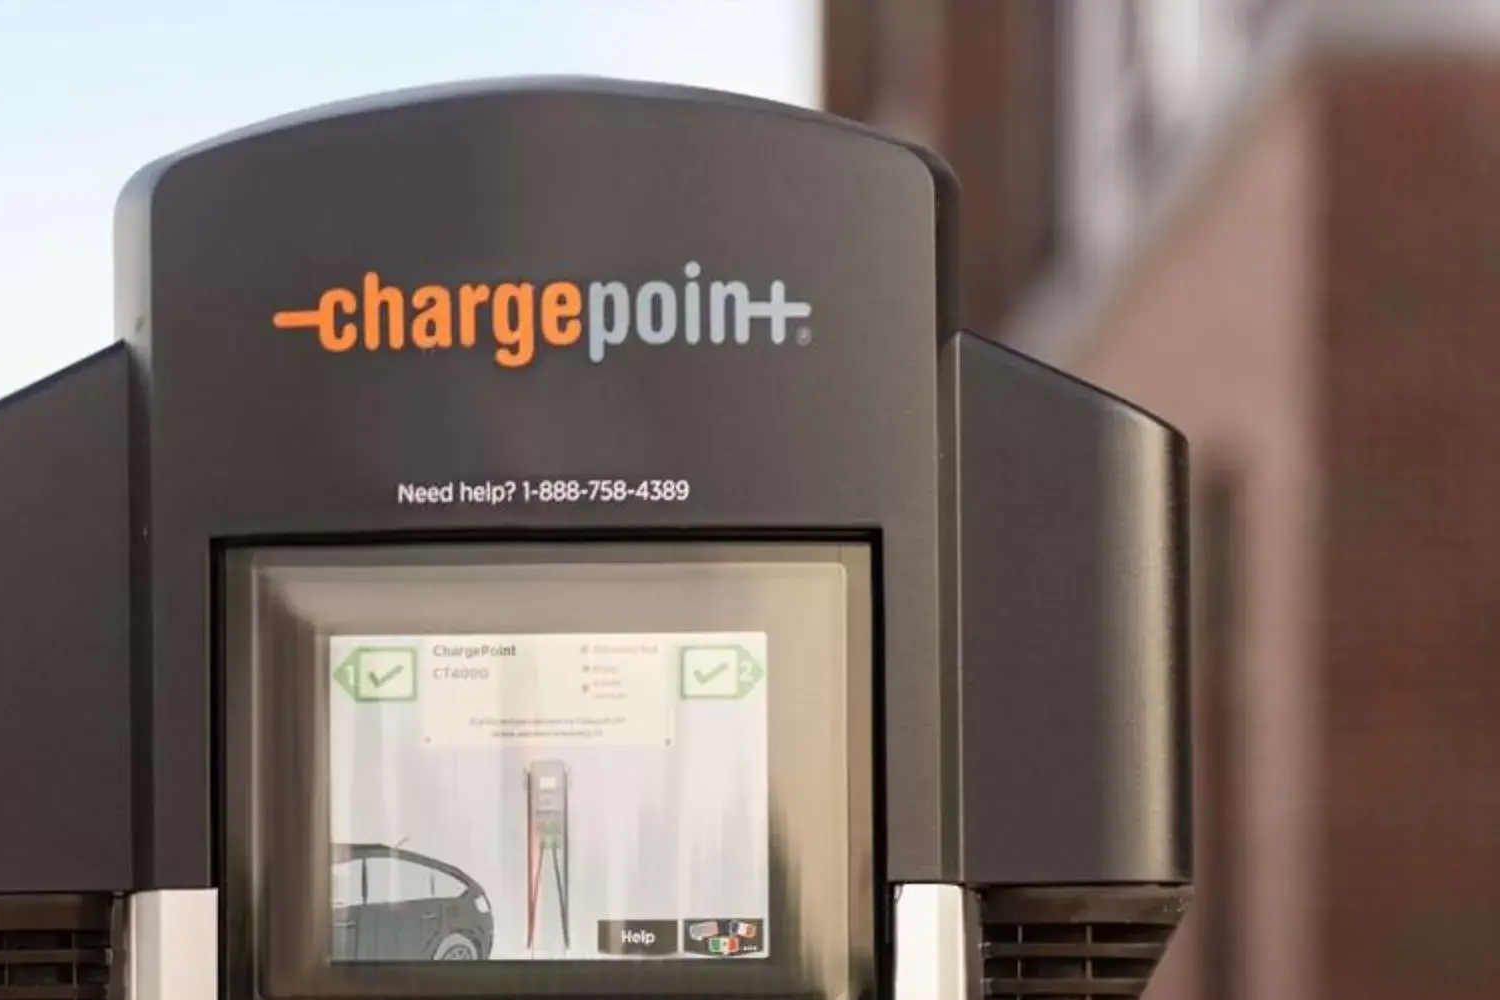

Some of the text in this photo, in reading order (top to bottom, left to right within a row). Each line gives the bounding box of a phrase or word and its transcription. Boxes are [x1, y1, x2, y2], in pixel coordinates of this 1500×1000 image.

[398, 479, 690, 504] Need help? 1-888-758-4389
[432, 644, 516, 659] ChargePoint
[621, 929, 656, 945] Help
